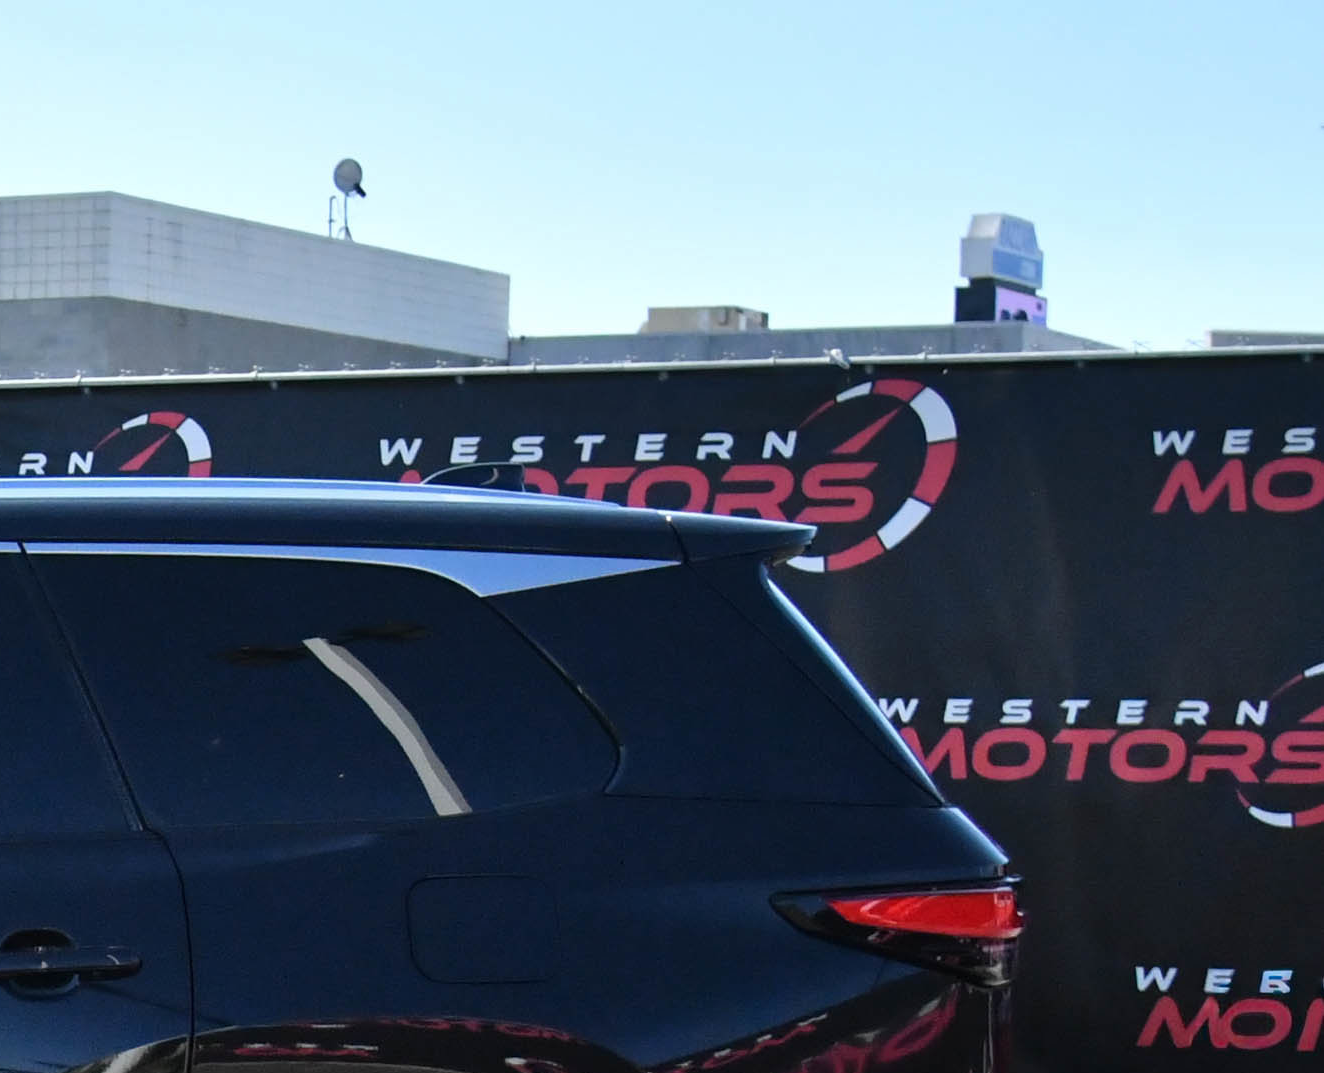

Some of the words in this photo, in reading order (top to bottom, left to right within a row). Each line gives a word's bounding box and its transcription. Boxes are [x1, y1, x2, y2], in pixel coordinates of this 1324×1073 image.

[379, 430, 799, 466] WESTERN
[1153, 427, 1316, 456] WES
[398, 462, 878, 523] TORS
[877, 698, 1269, 726] WESTERN
